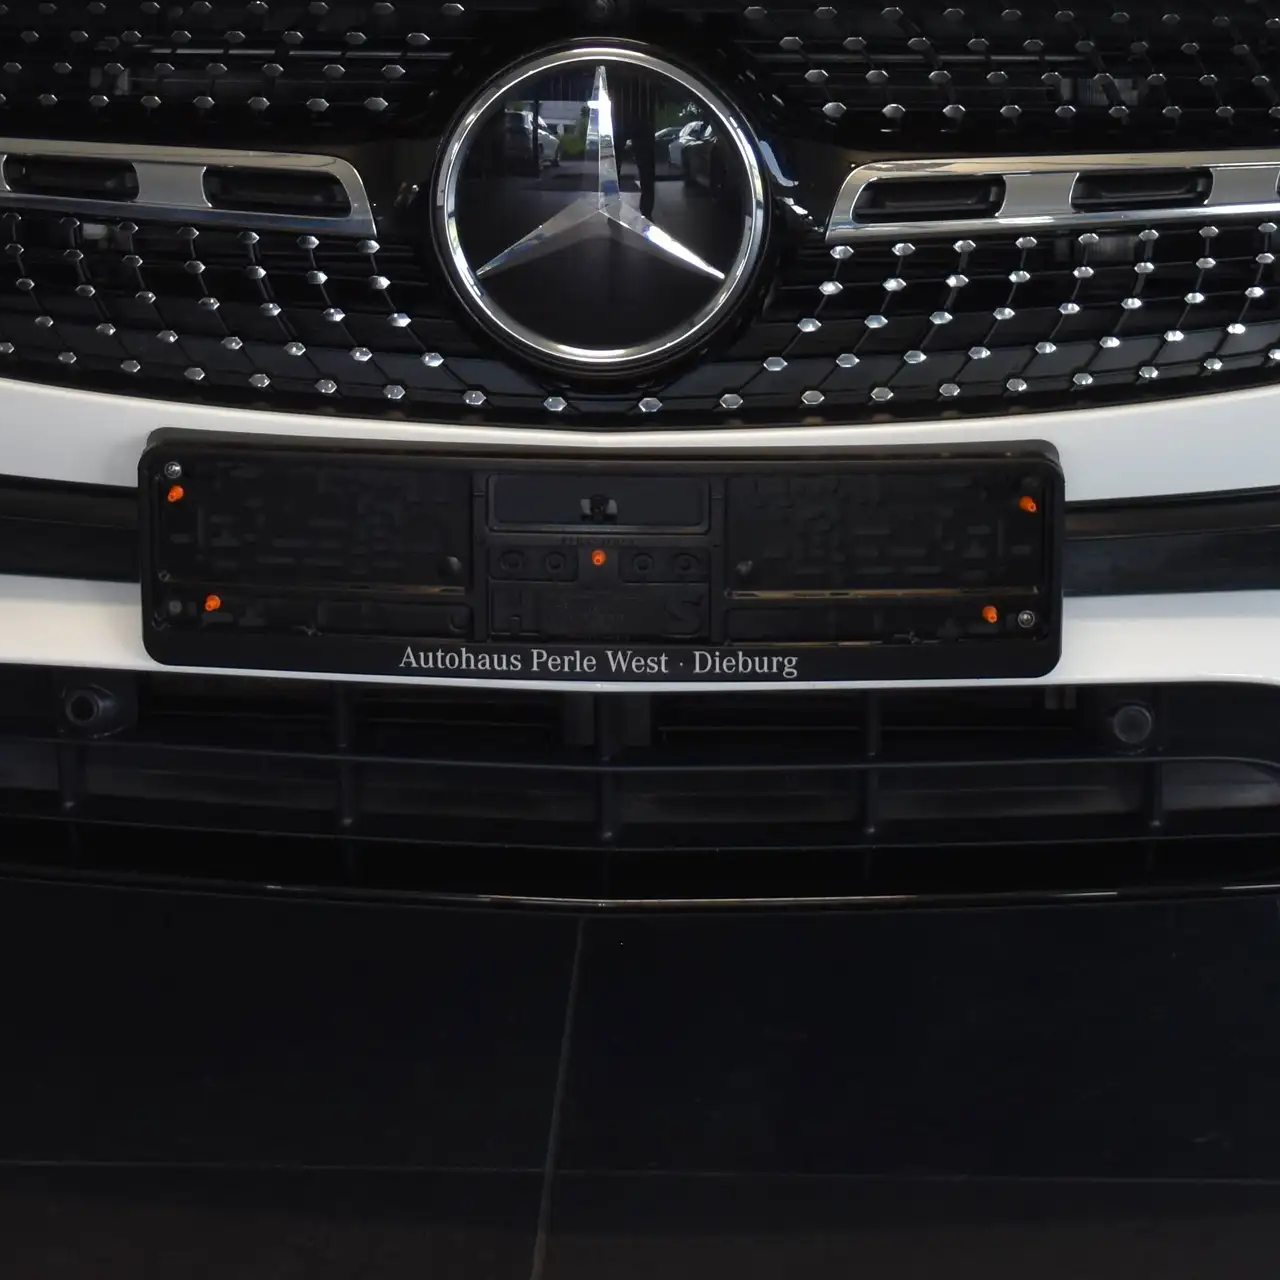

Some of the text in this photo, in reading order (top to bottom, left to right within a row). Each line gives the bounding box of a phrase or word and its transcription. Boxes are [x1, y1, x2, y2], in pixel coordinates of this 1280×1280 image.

[399, 646, 799, 679] Autohaus Perle West Dieburg
